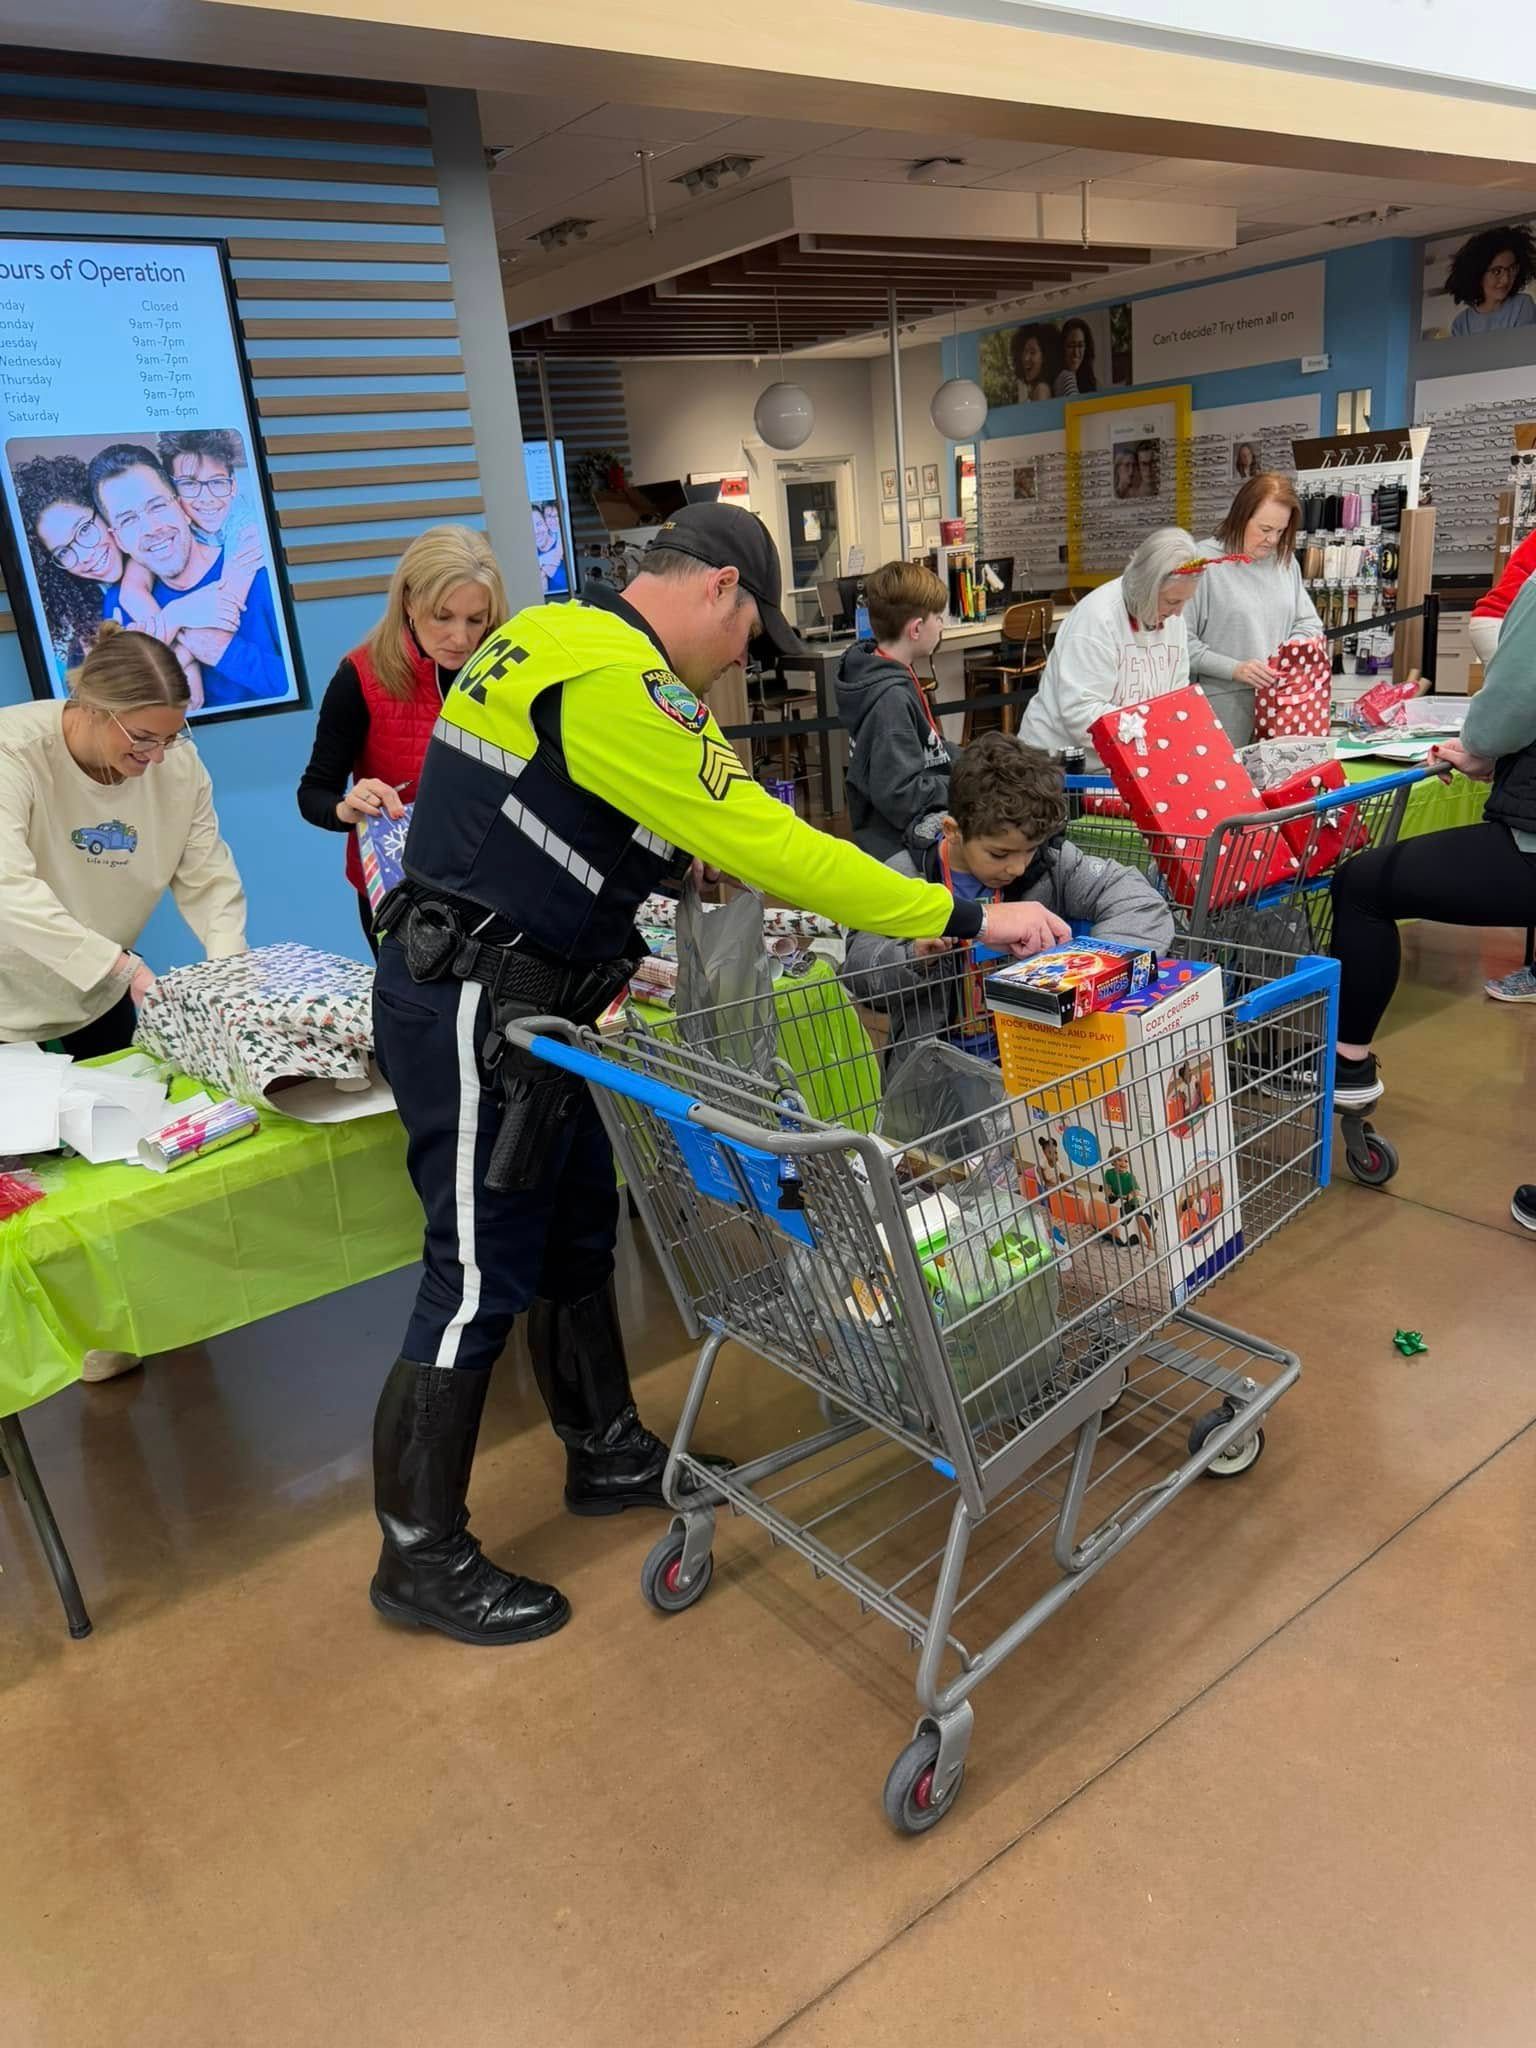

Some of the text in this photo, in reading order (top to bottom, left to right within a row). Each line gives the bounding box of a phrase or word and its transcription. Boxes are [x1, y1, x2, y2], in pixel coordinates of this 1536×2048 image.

[50, 258, 73, 280] of
[78, 258, 186, 287] Operation
[141, 300, 179, 312] Closed
[128, 318, 182, 332] 9am-7pm
[1152, 311, 1295, 346] Can't decide? Try them all on
[132, 335, 185, 350] 9am-7pm
[136, 353, 189, 368] 9am-7pm
[0, 370, 193, 388] Thursday 9am-7pm
[4, 387, 196, 406] Friday 9am-7pm
[8, 404, 199, 424] Saturday 9am-6pm
[1145, 992, 1200, 1032] COZY CRUISERS
[1068, 1029, 1087, 1039] AND
[1089, 1031, 1115, 1043] PLAY!
